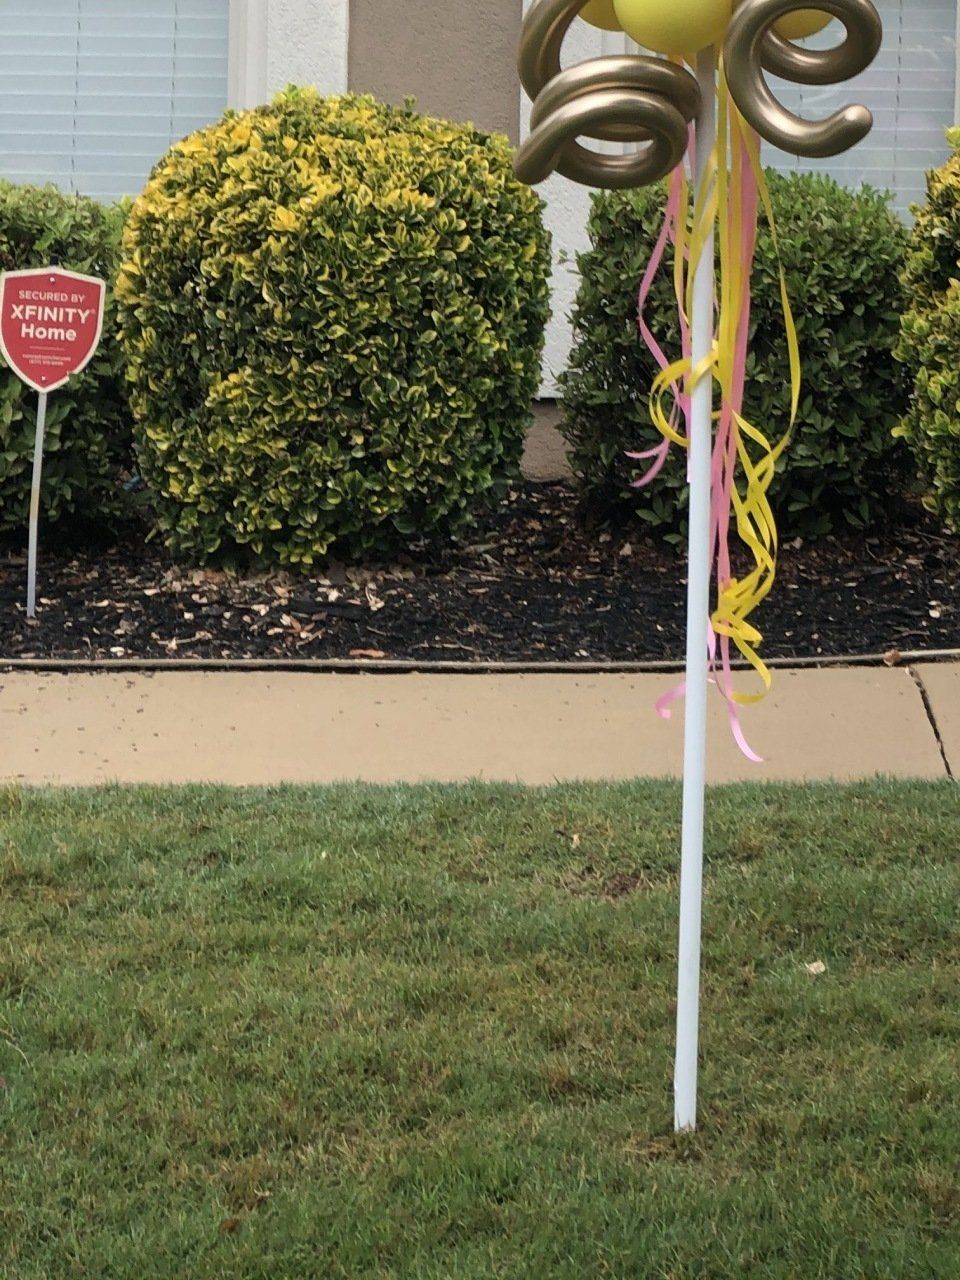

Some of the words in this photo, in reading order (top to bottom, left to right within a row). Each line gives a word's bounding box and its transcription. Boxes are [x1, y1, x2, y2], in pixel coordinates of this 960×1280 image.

[18, 289, 69, 303] SECURED
[70, 293, 86, 303] BY
[10, 303, 91, 324] XFINITY
[20, 322, 77, 341] Home
